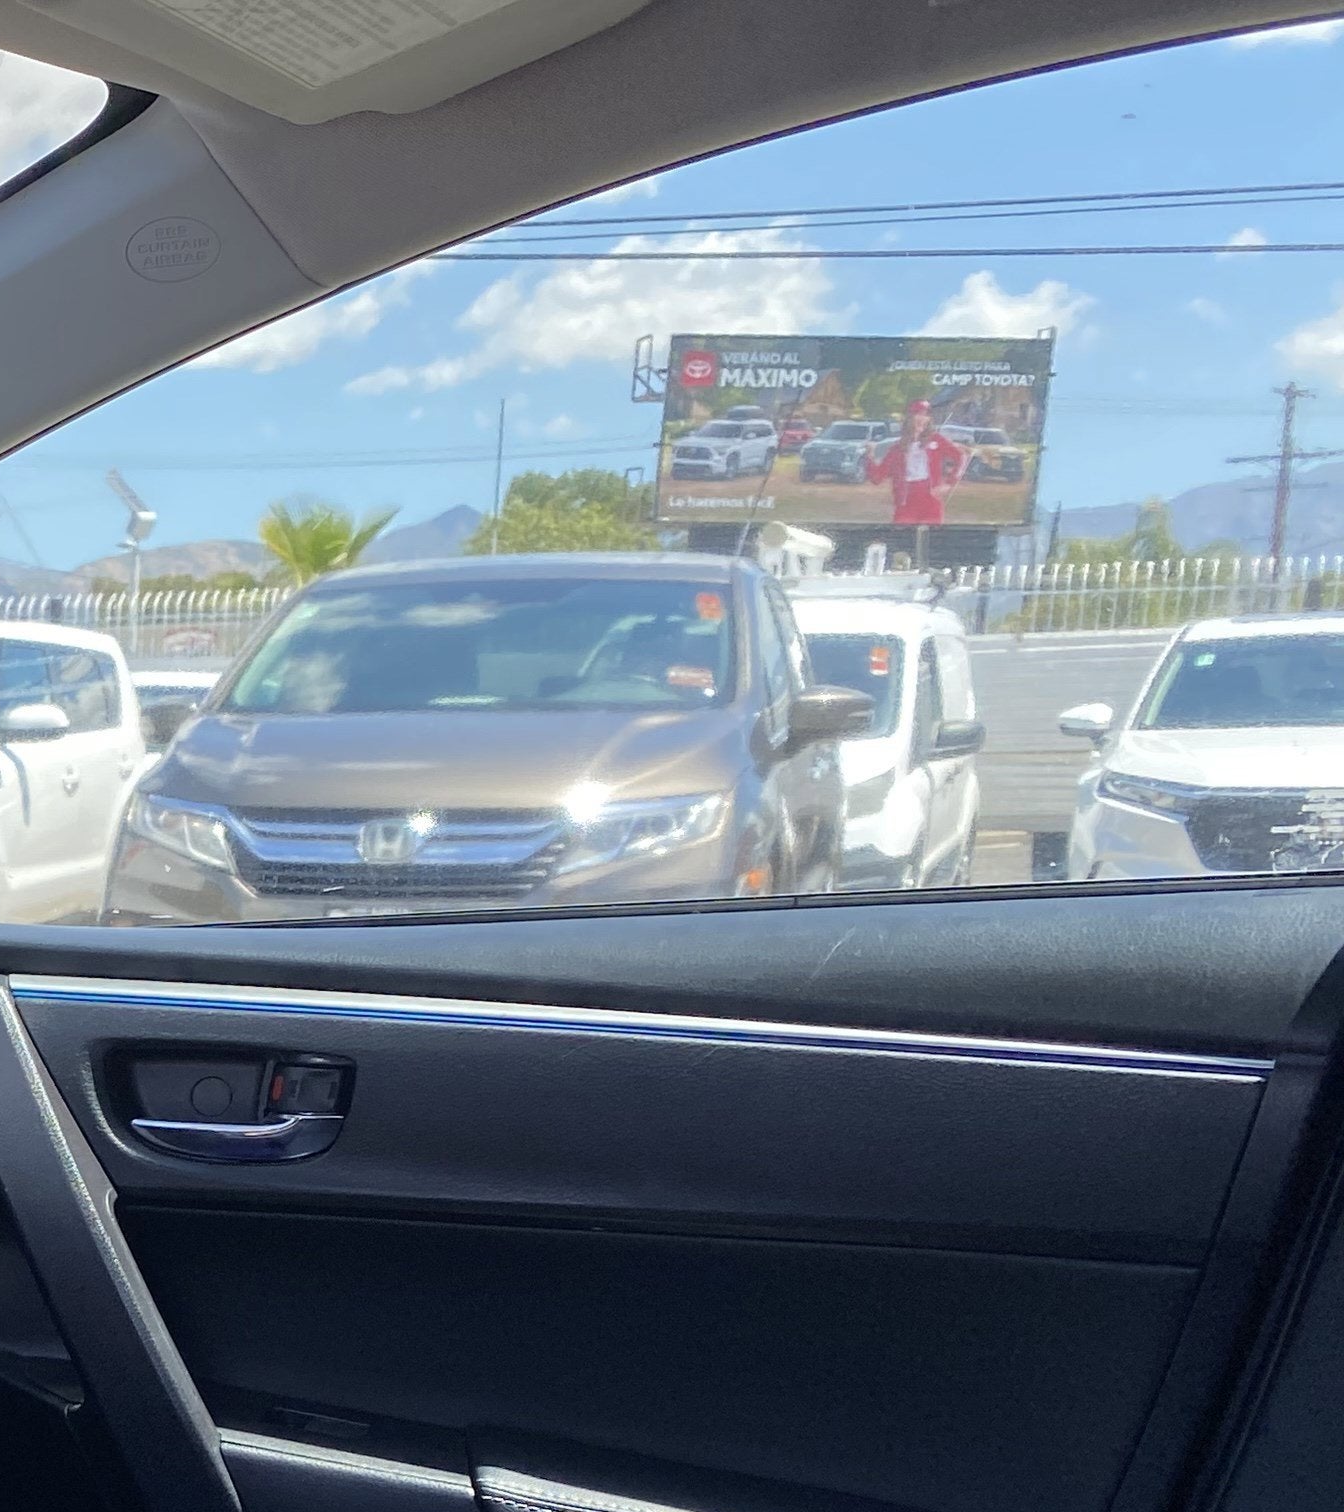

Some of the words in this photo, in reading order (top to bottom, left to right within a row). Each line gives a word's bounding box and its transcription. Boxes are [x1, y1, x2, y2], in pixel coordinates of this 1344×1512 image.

[137, 238, 210, 254] CURTAIN
[143, 251, 208, 267] AIRBAG
[783, 352, 801, 364] AL
[932, 373, 973, 386] CAMP
[975, 373, 1035, 386] TOYOTA?
